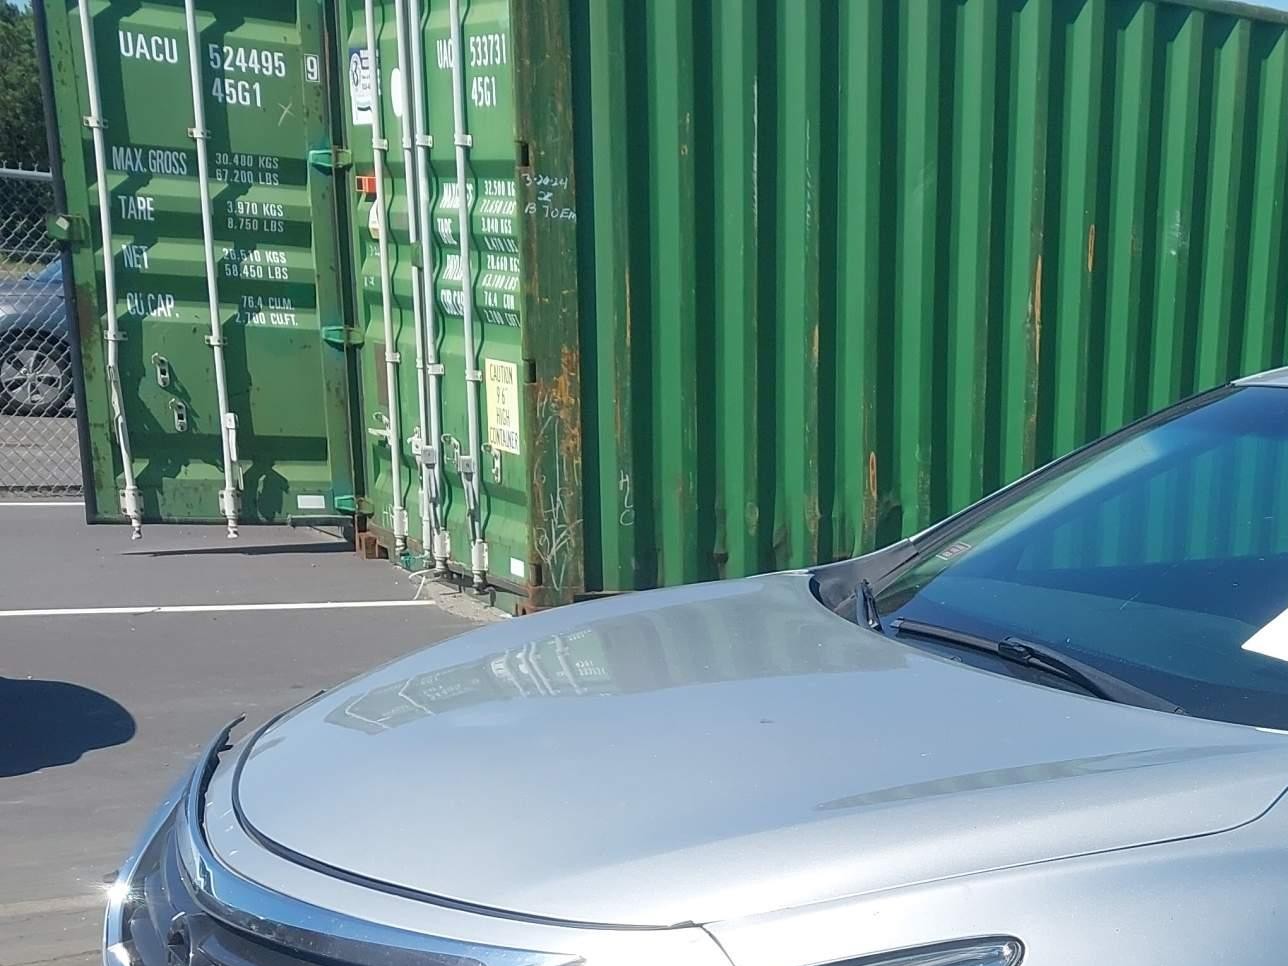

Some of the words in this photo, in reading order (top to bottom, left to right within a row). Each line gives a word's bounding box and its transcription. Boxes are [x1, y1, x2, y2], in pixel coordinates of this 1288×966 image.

[119, 31, 178, 64] UACU
[208, 44, 286, 77] 524495
[306, 56, 318, 80] 9
[469, 34, 507, 67] 533731
[211, 77, 261, 107] 45G1
[471, 76, 497, 107] 45G1
[215, 152, 253, 167] 30.480
[258, 157, 279, 169] KGS
[215, 169, 254, 184] 67.200
[258, 172, 279, 186] LBS
[118, 195, 155, 221] TARE
[227, 201, 258, 215] 3.970
[262, 203, 284, 217] KGS
[227, 217, 258, 231] 8.750
[263, 219, 284, 232] LBS
[122, 244, 149, 269] NET
[223, 247, 261, 263] 26.510
[265, 251, 287, 264] KGS
[225, 264, 263, 278] 58.450
[268, 266, 289, 280] LBS
[241, 295, 263, 309] 76.4
[489, 363, 513, 384] CAUTION
[489, 427, 518, 449] CONTAINER
